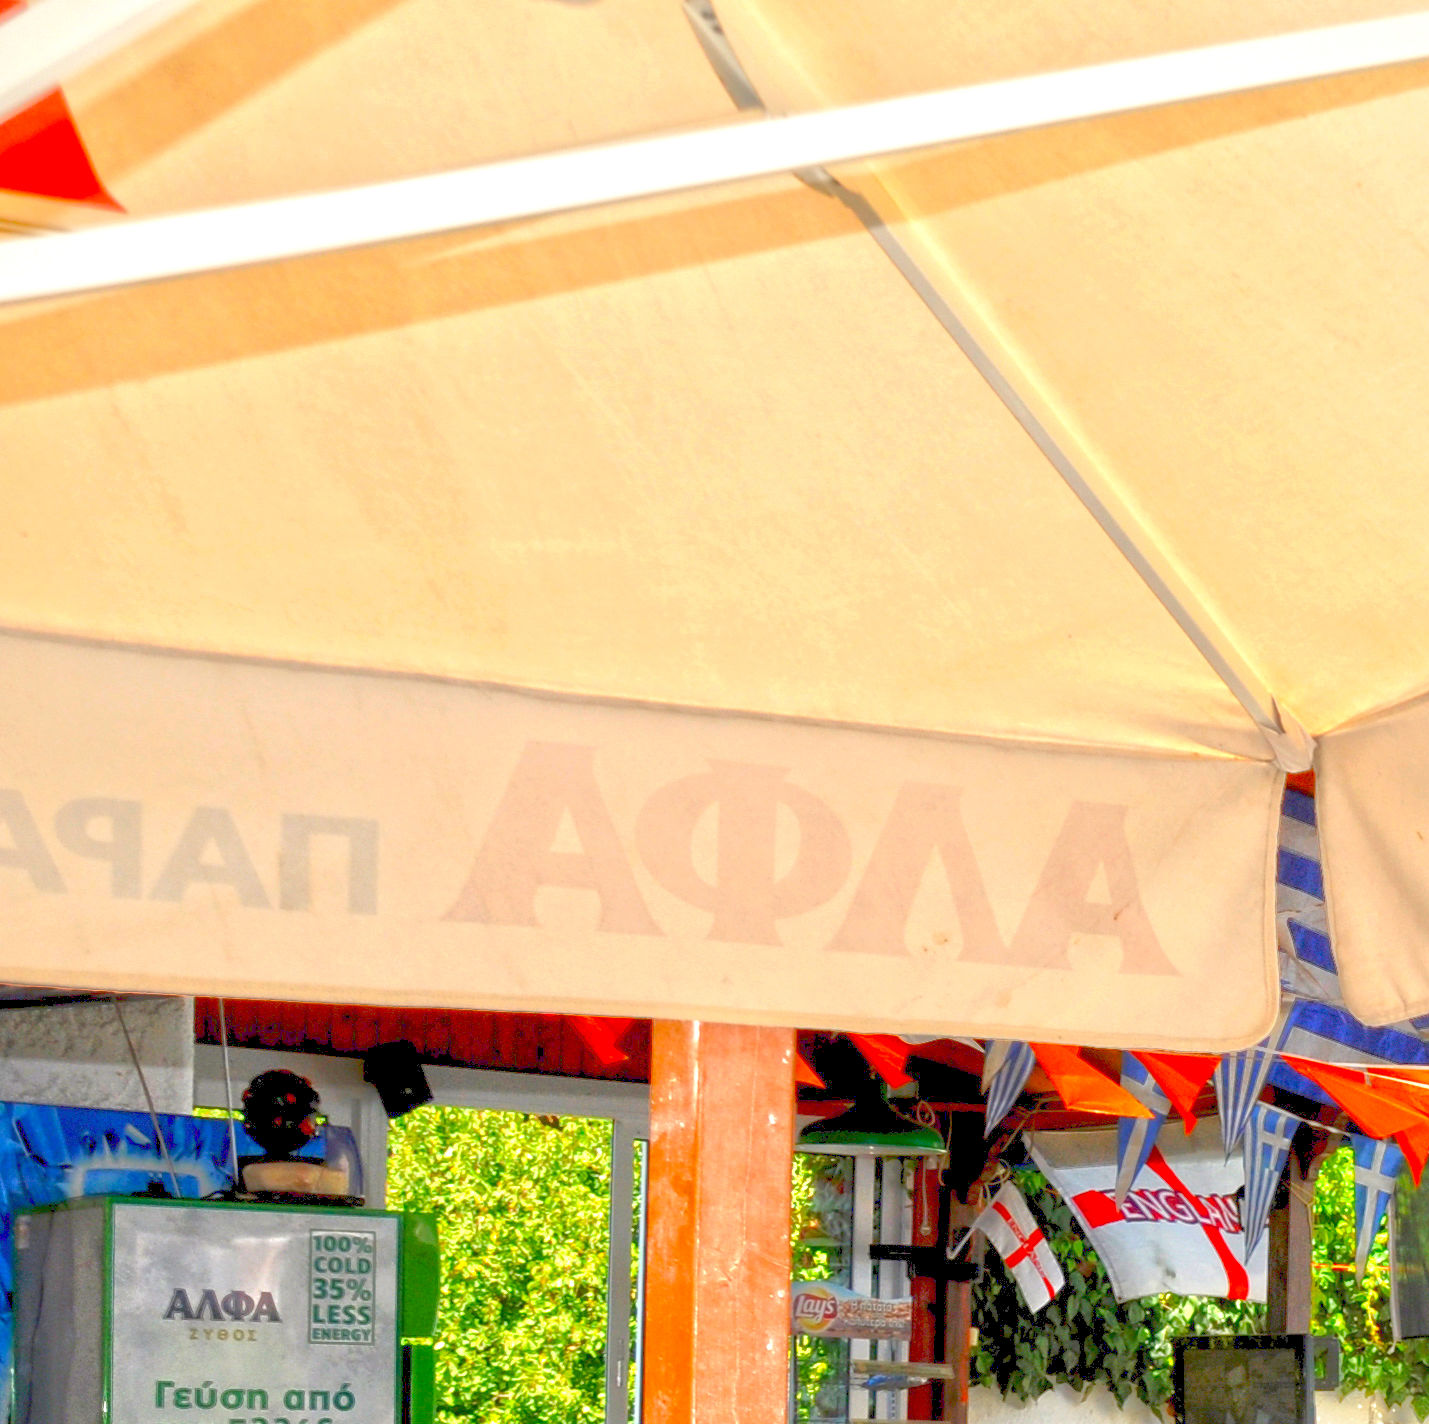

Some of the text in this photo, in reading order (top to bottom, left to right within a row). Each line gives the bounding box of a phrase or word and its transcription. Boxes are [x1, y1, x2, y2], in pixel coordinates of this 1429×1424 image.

[1102, 1189, 1262, 1233] ENGLAN
[312, 1236, 372, 1254] 100%
[314, 1257, 371, 1275] COLD
[313, 1279, 372, 1302] 35%
[165, 1289, 282, 1323] ΑΛΦΑ
[312, 1305, 371, 1325] LESS
[794, 1294, 837, 1323] Lay's
[311, 1327, 371, 1342] ENERGY
[155, 1380, 356, 1412] Γεύση από
